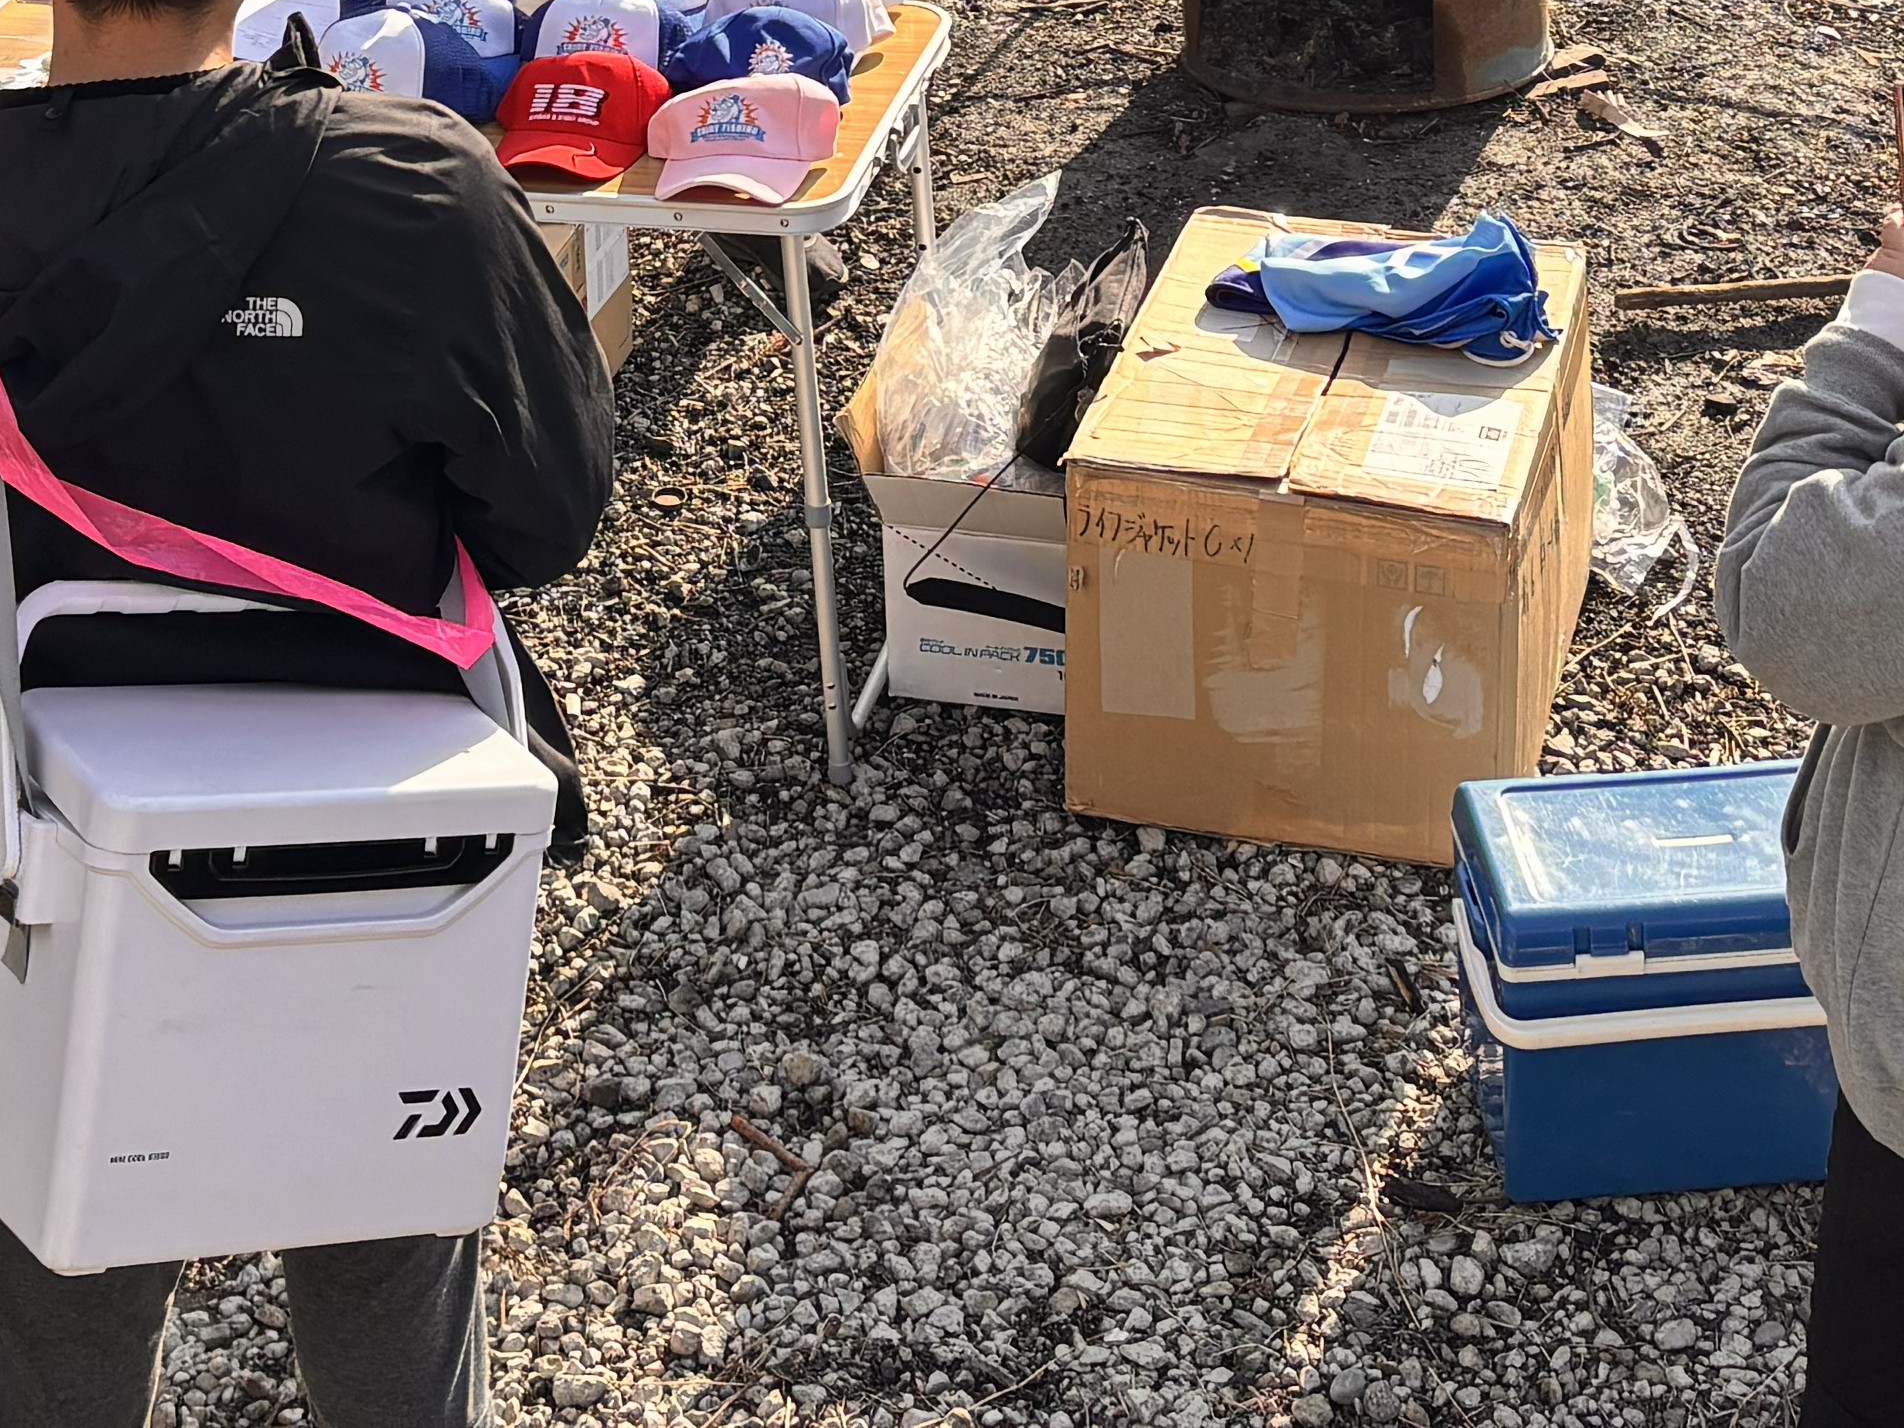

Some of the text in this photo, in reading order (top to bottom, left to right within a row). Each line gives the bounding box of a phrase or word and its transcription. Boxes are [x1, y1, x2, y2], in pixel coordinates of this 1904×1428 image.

[245, 296, 277, 310] THE
[221, 309, 277, 324] NORTH
[236, 323, 277, 337] FACE
[1078, 505, 1195, 557] ライフジャケット
[919, 643, 962, 656] COOL
[964, 647, 978, 658] IN
[980, 649, 1021, 662] PACK
